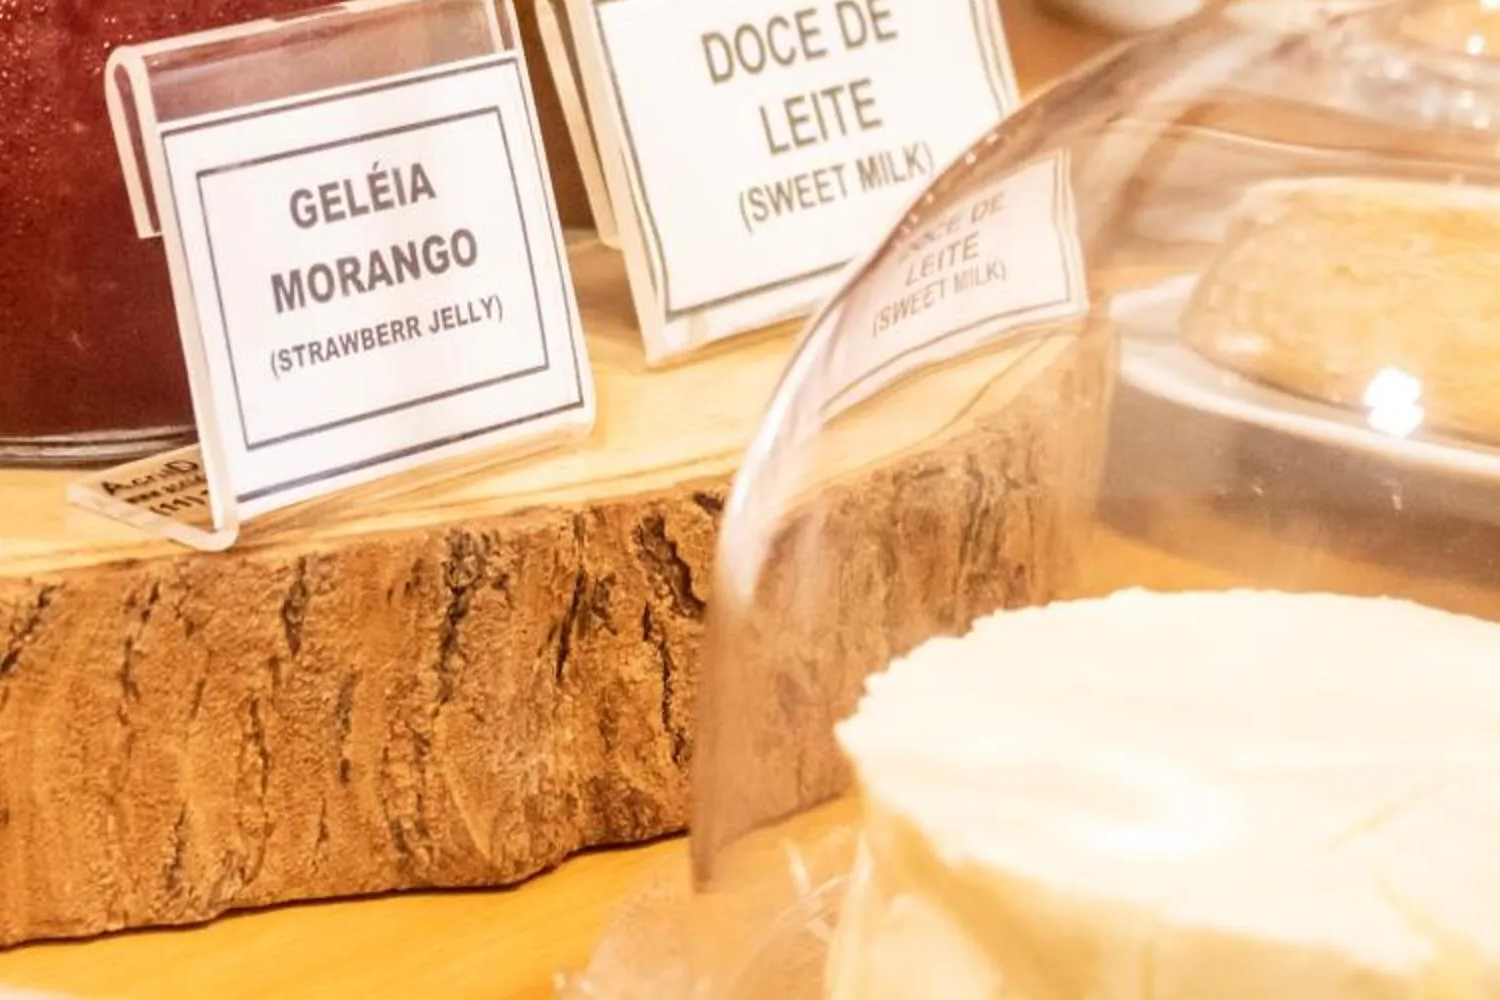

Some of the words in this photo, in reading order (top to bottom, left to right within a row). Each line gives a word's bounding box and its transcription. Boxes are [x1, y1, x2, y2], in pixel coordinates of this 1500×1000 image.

[702, 8, 828, 83] DOCE
[760, 79, 882, 155] LEITE
[289, 160, 436, 228] GELÉIA
[739, 164, 849, 232] (SWEET
[856, 141, 933, 192] MILK)
[271, 229, 478, 313] MORANGO
[905, 232, 979, 286] LEITE
[270, 316, 422, 378] (STRAWBERR
[429, 294, 503, 333] JELLY)
